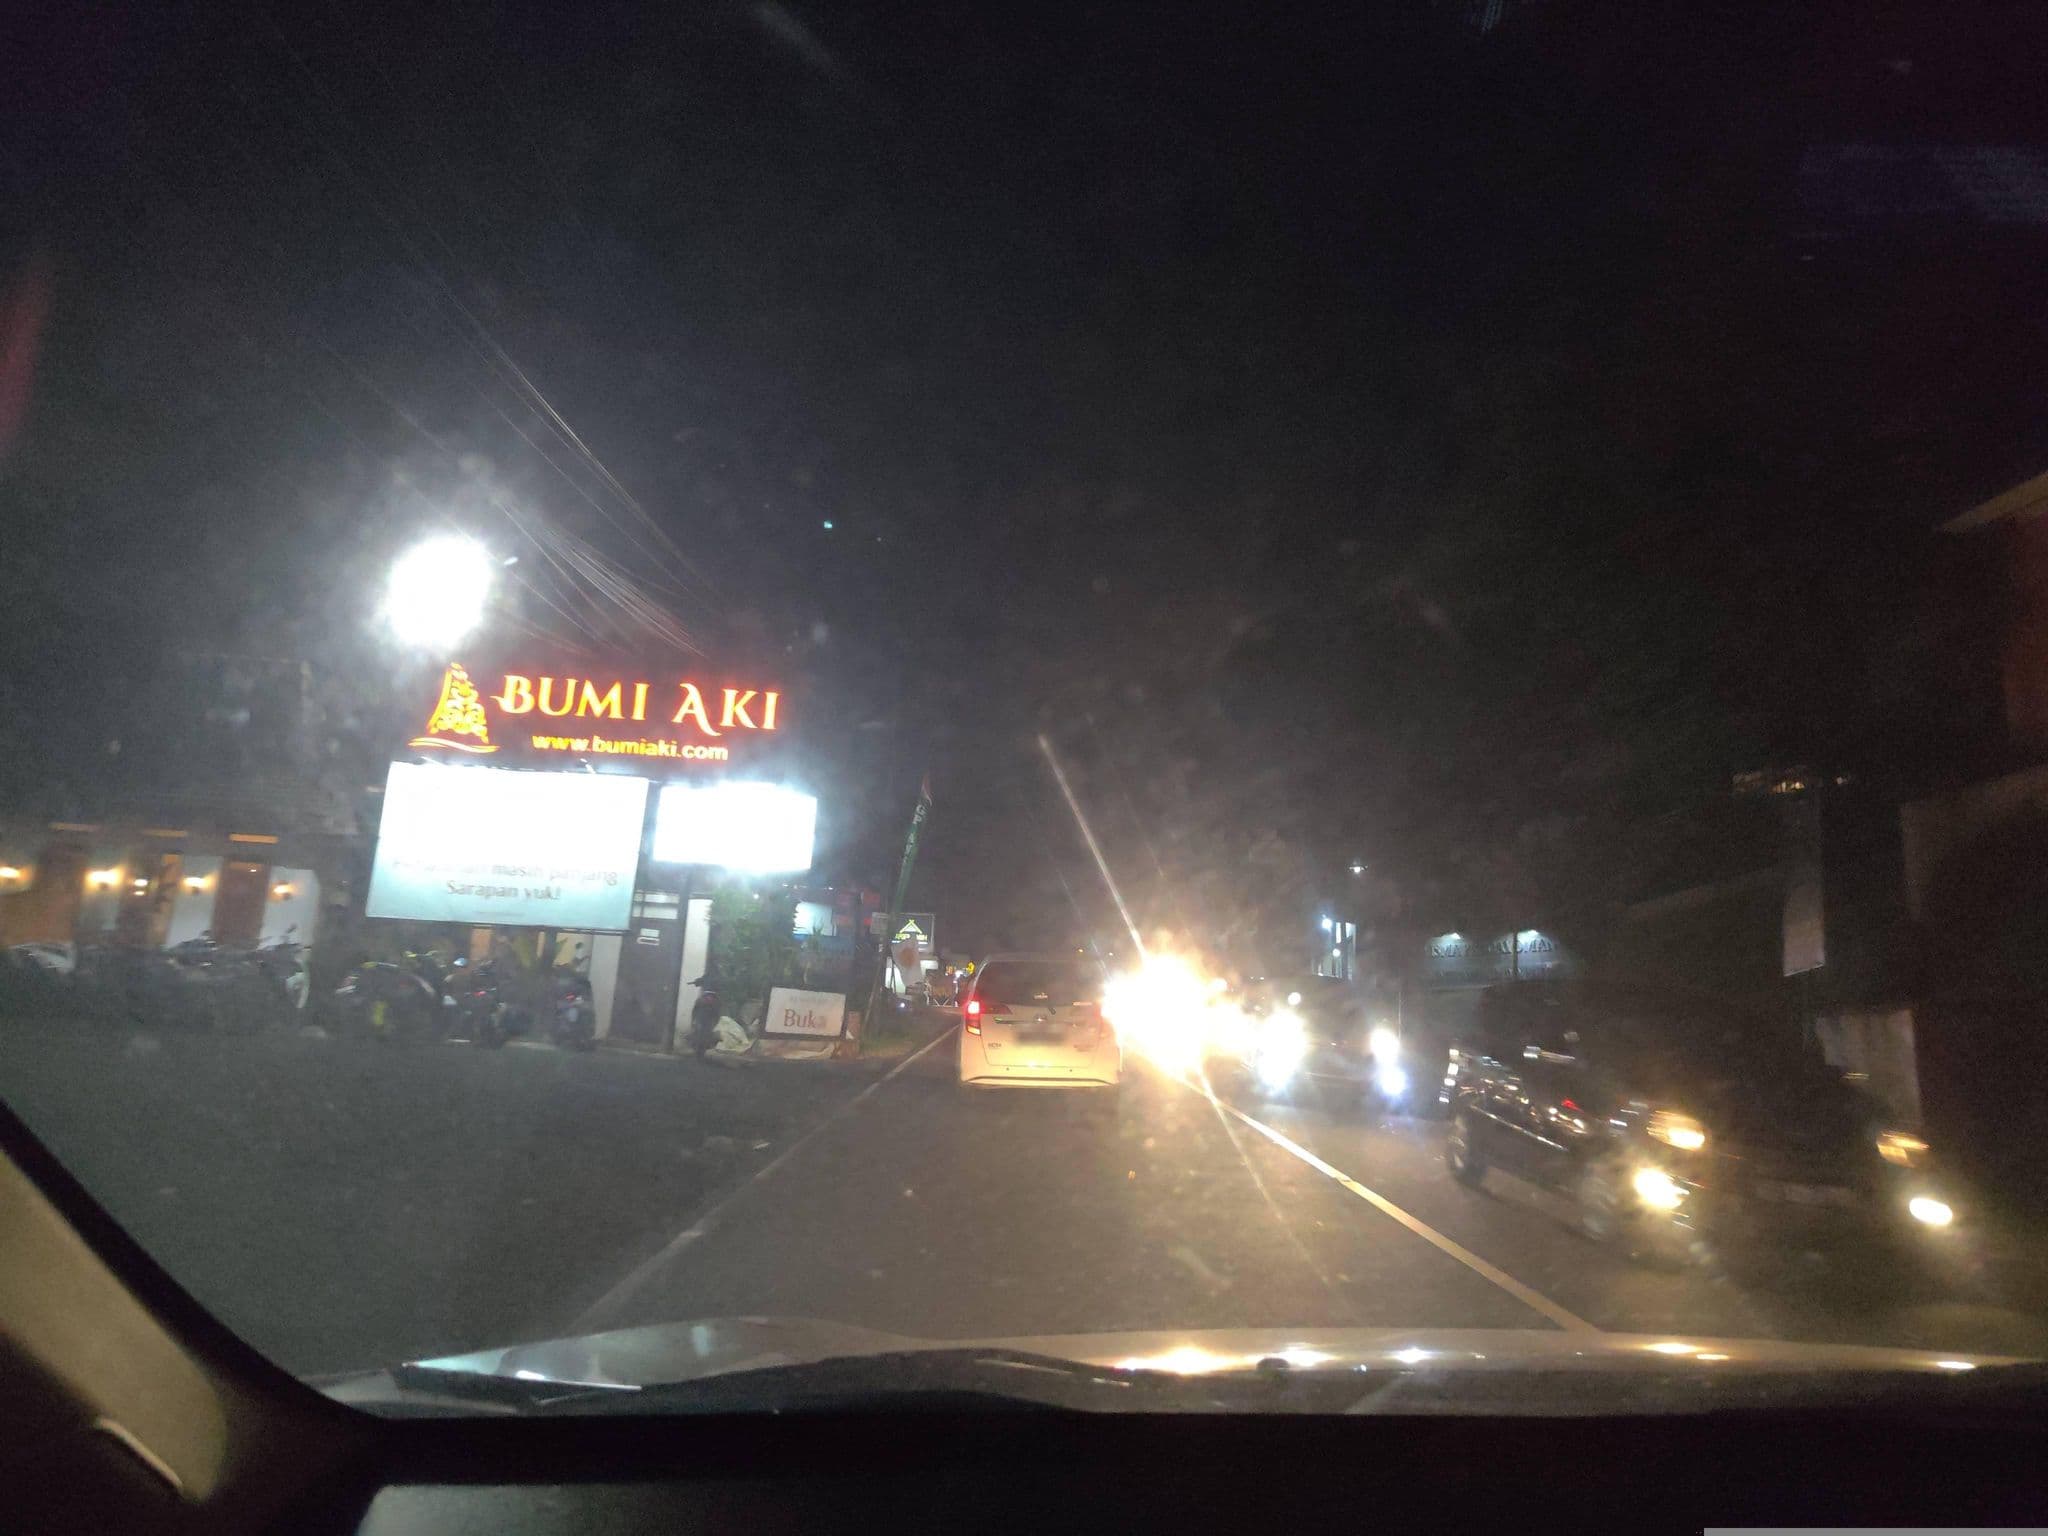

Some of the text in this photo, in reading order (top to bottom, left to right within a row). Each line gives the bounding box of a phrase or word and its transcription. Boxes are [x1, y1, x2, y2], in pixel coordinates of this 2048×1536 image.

[490, 674, 780, 737] BUMI AKI
[532, 733, 729, 761] www.bumiaki.com
[447, 880, 519, 899] Sarapan
